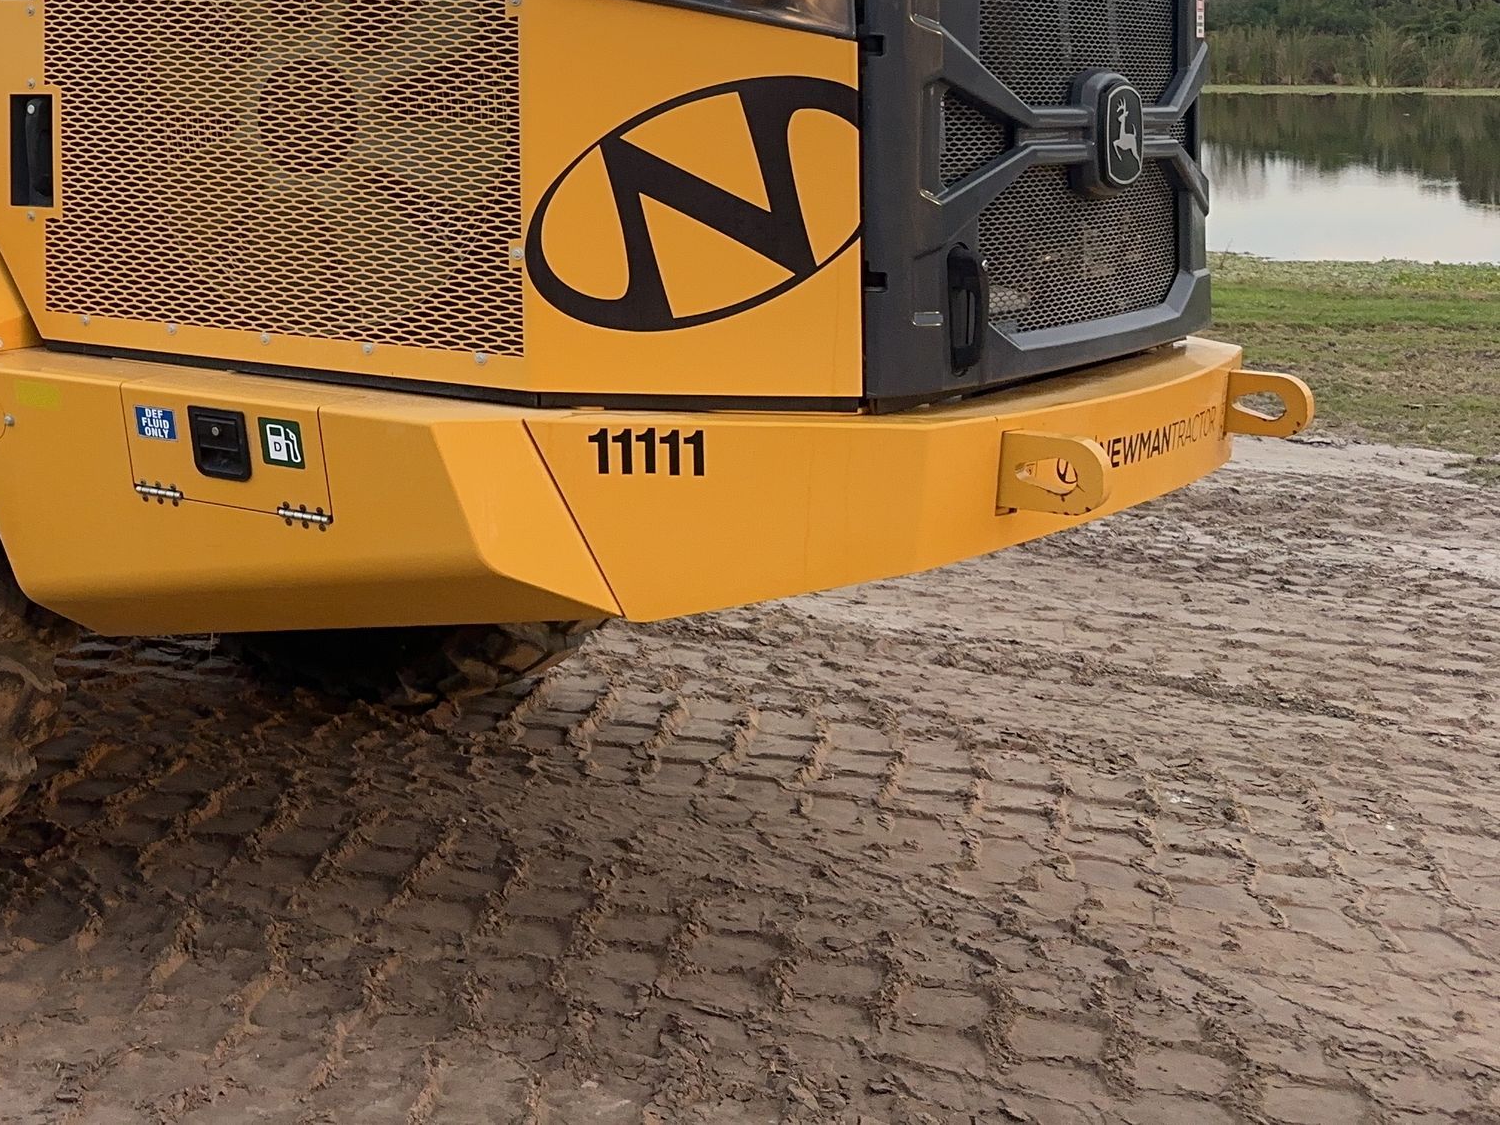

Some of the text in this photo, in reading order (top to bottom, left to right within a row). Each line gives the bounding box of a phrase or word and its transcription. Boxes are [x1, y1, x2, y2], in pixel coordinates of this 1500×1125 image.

[145, 408, 163, 419] DEF
[141, 416, 170, 429] FLUID
[144, 426, 169, 438] ONLY
[274, 441, 282, 452] D
[588, 427, 705, 476] 11111
